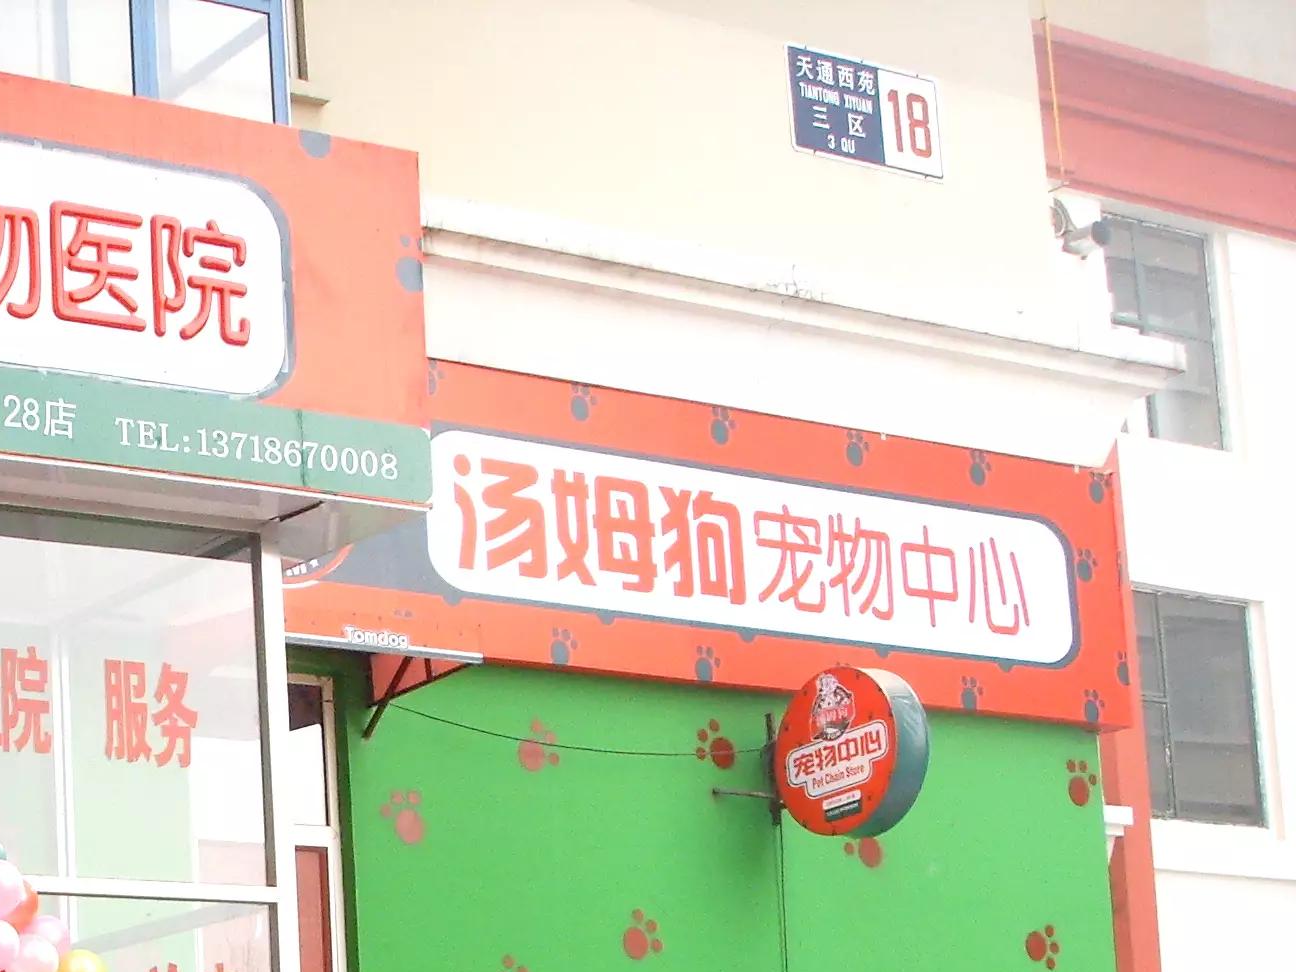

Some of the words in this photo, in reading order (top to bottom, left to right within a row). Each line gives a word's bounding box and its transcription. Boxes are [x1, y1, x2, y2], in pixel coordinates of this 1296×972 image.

[796, 55, 876, 96] 天通西苑
[799, 82, 840, 106] TIANTONG
[844, 93, 873, 115] XIYUAN
[887, 89, 933, 158] 18
[827, 134, 836, 149] 3
[841, 138, 856, 153] QU
[344, 625, 410, 650] Tomdog
[104, 658, 198, 768] 服务
[793, 730, 882, 778] 宠物中心
[825, 769, 845, 785] Chain
